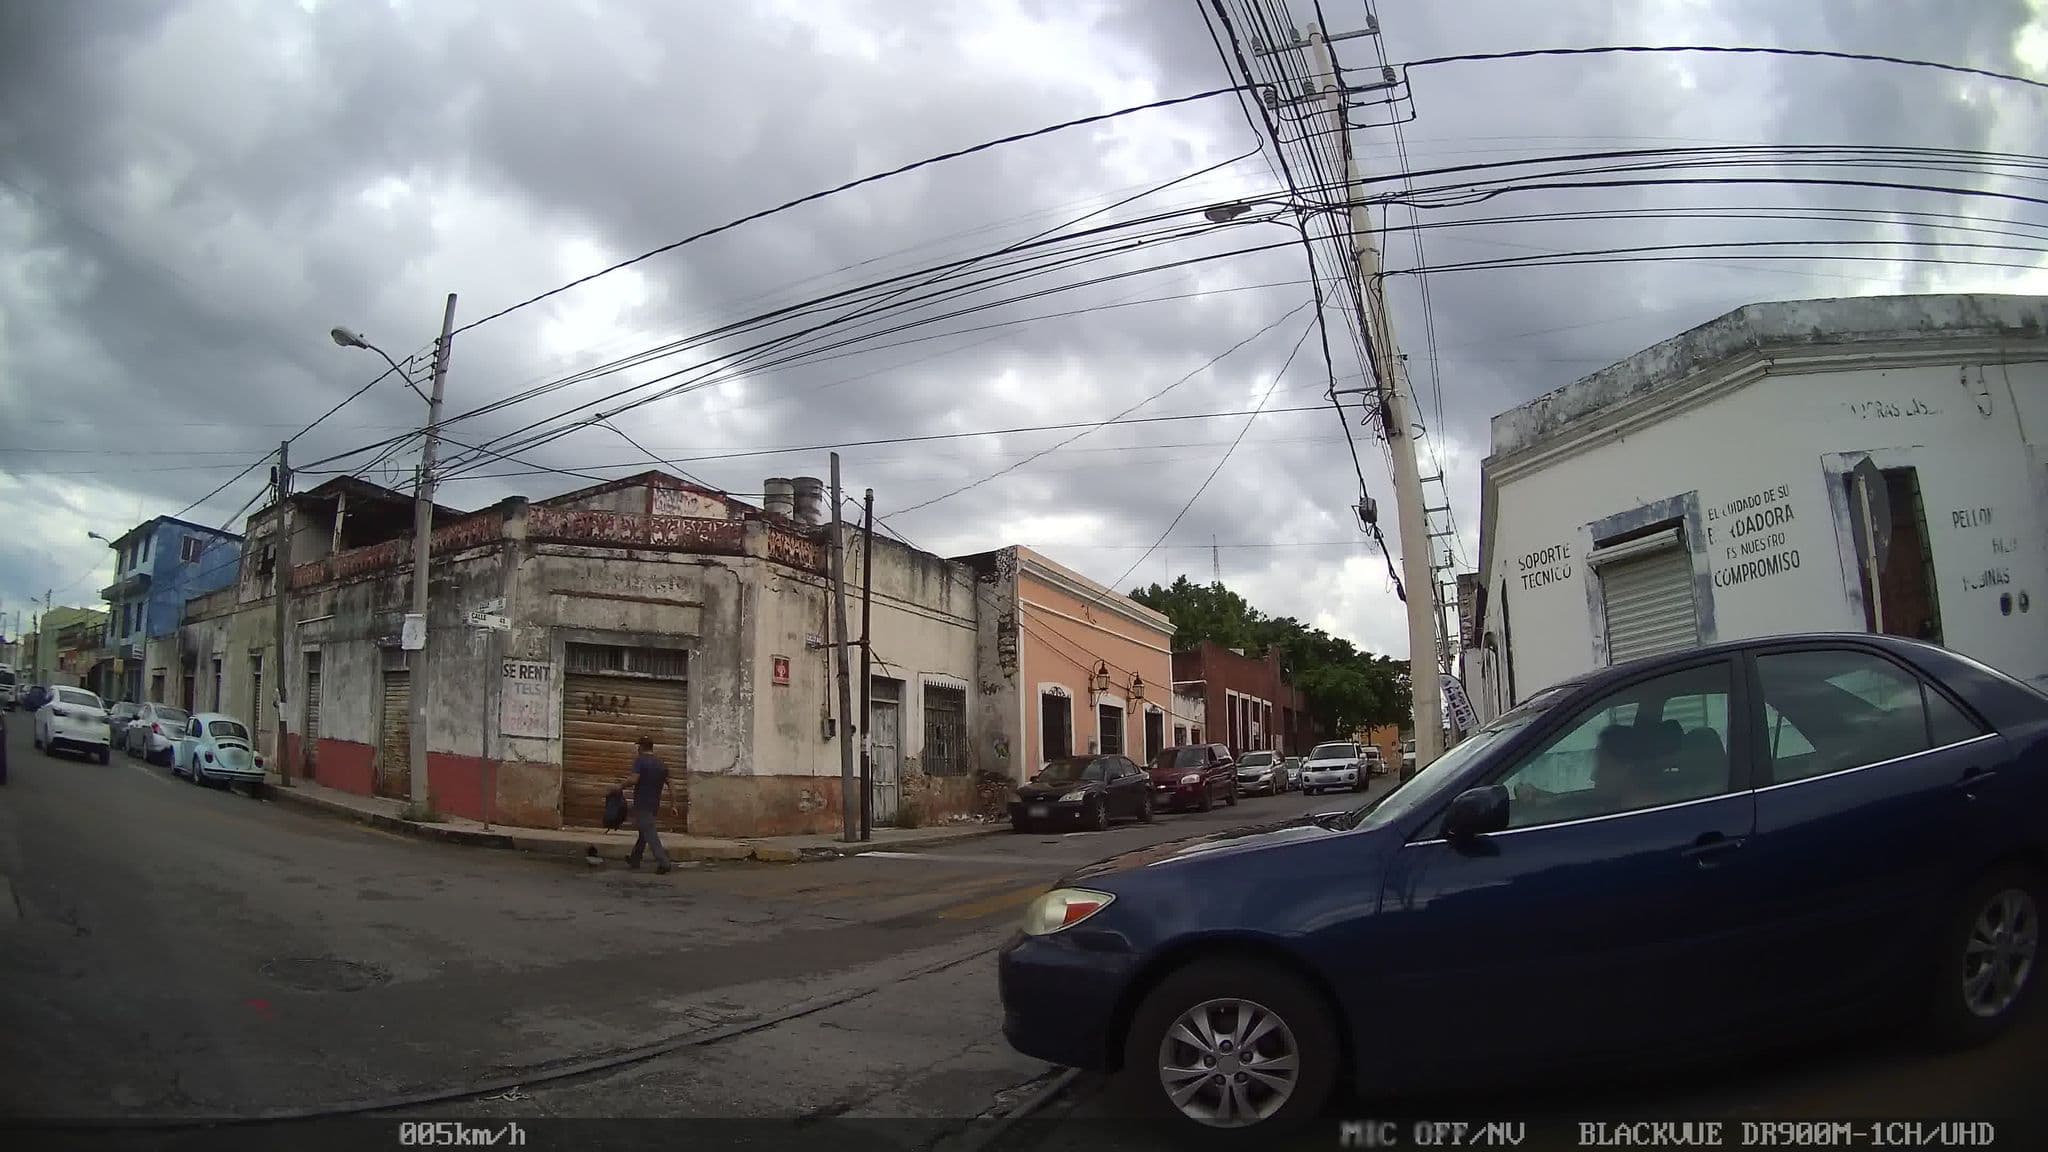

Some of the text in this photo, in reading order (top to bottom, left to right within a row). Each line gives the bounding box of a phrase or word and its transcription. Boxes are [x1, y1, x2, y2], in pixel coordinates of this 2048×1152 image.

[1707, 508, 1720, 521] EL
[1763, 489, 1776, 504] DE
[1778, 483, 1789, 499] SU
[1518, 543, 1571, 571] SOPORTE
[1741, 532, 1786, 556] NUESTRO
[1520, 564, 1572, 590] TECNICO
[1714, 549, 1801, 588] COMPROMISO
[503, 663, 517, 679] SE
